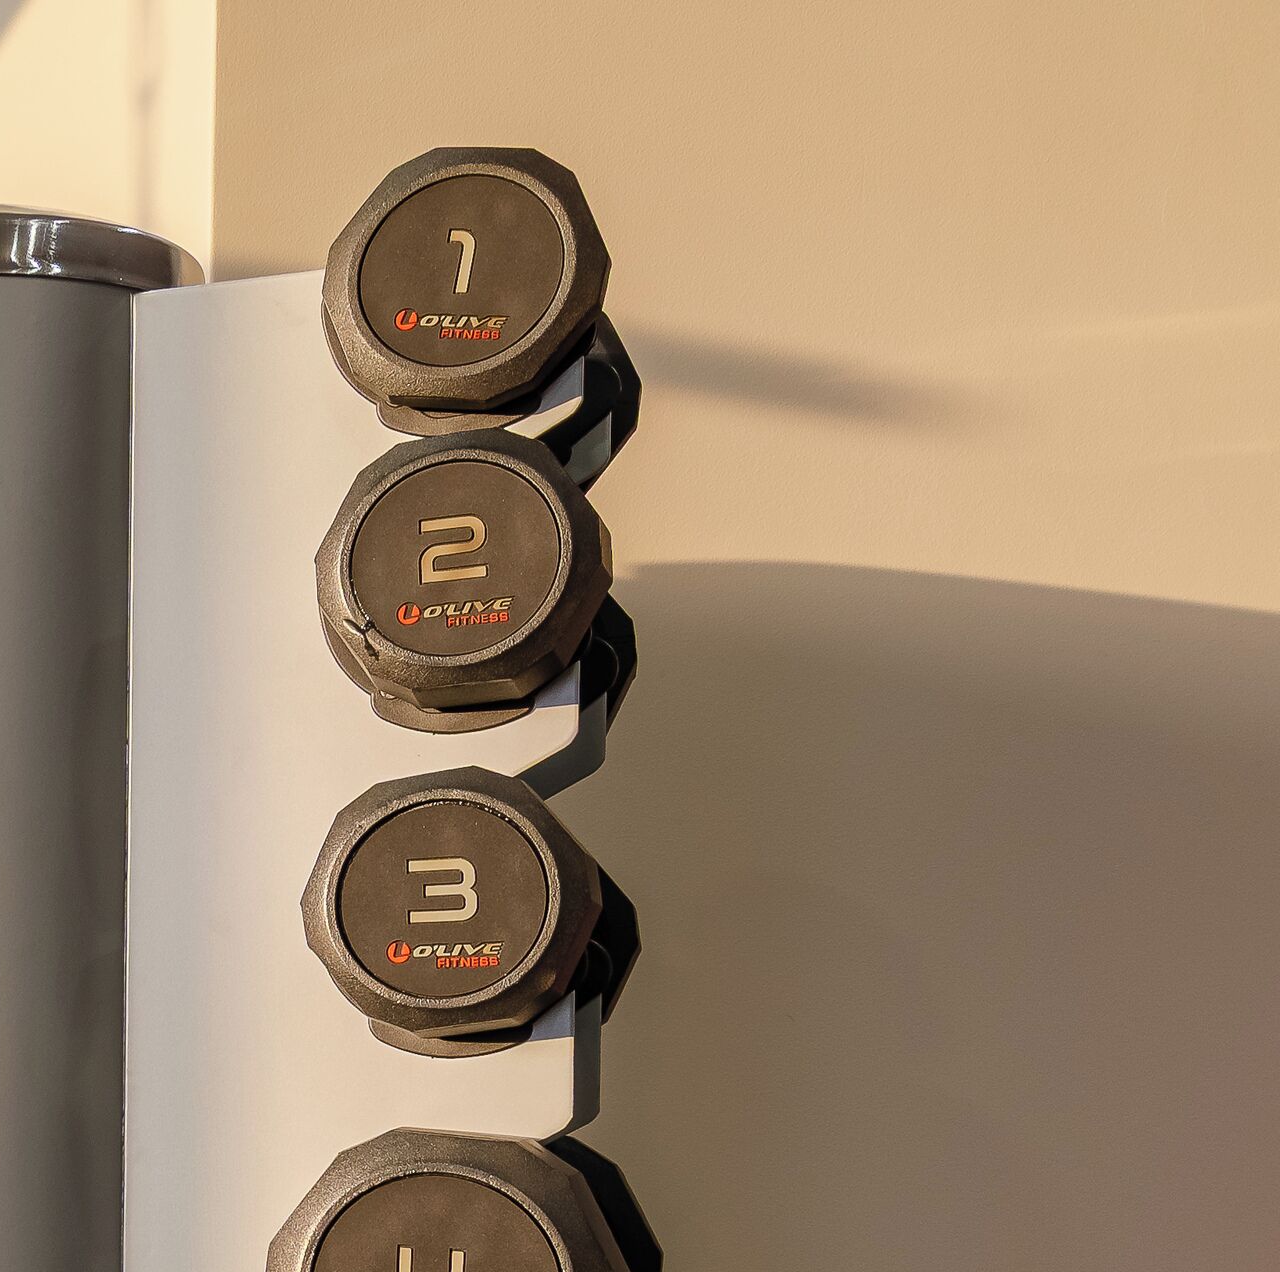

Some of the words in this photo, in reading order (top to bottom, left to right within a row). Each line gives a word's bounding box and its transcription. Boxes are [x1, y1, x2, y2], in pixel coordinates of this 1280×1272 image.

[449, 229, 476, 294] 1
[420, 315, 509, 328] O'LIVE
[440, 328, 500, 339] FITNESS
[419, 514, 488, 585] 2
[423, 596, 514, 618] O'LIVE
[447, 612, 508, 628] FITNESS
[407, 857, 478, 924] 3
[413, 942, 503, 958] O'LIVE
[437, 956, 500, 969] FITNESS
